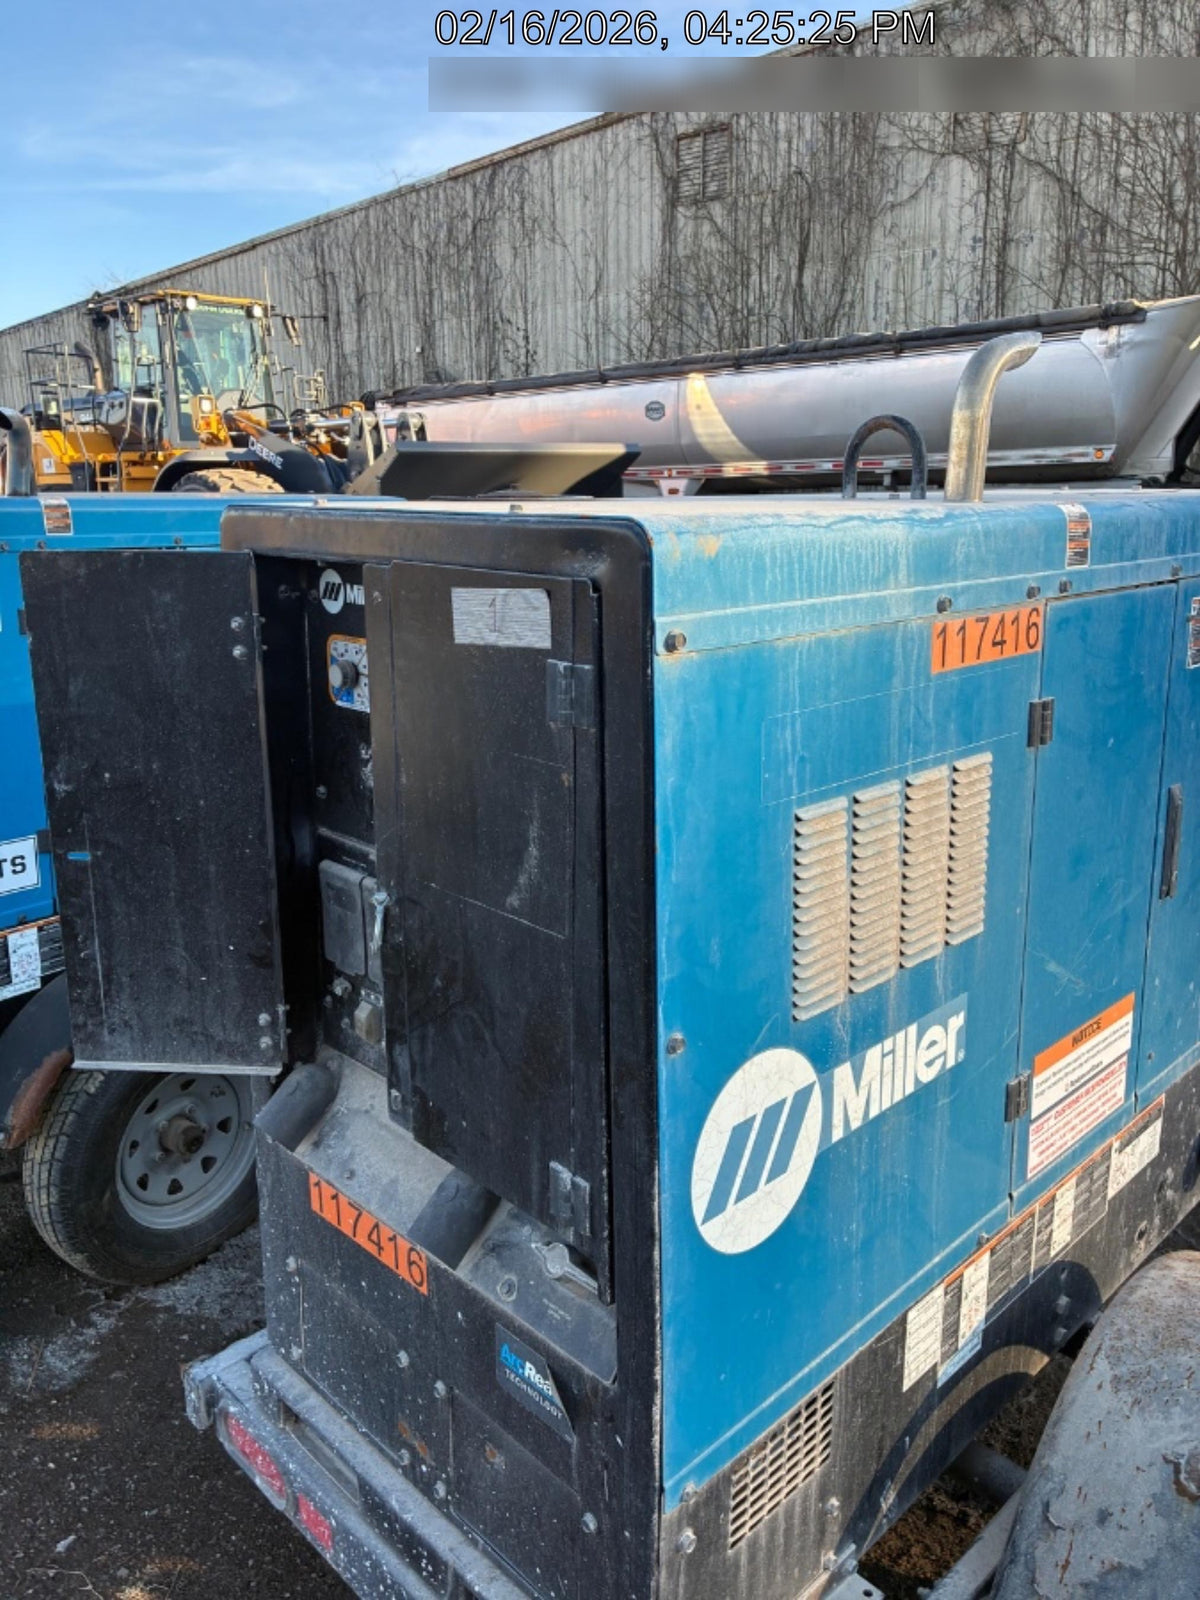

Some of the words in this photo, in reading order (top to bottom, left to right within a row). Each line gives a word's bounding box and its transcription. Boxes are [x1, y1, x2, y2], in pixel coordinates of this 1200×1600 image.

[249, 435, 283, 470] DEERE
[937, 607, 1040, 669] 117416
[1071, 1017, 1103, 1048] NOTICE
[831, 1010, 965, 1144] Miller
[313, 1180, 425, 1287] 117416
[504, 1368, 562, 1420] TECHNOLOGY
